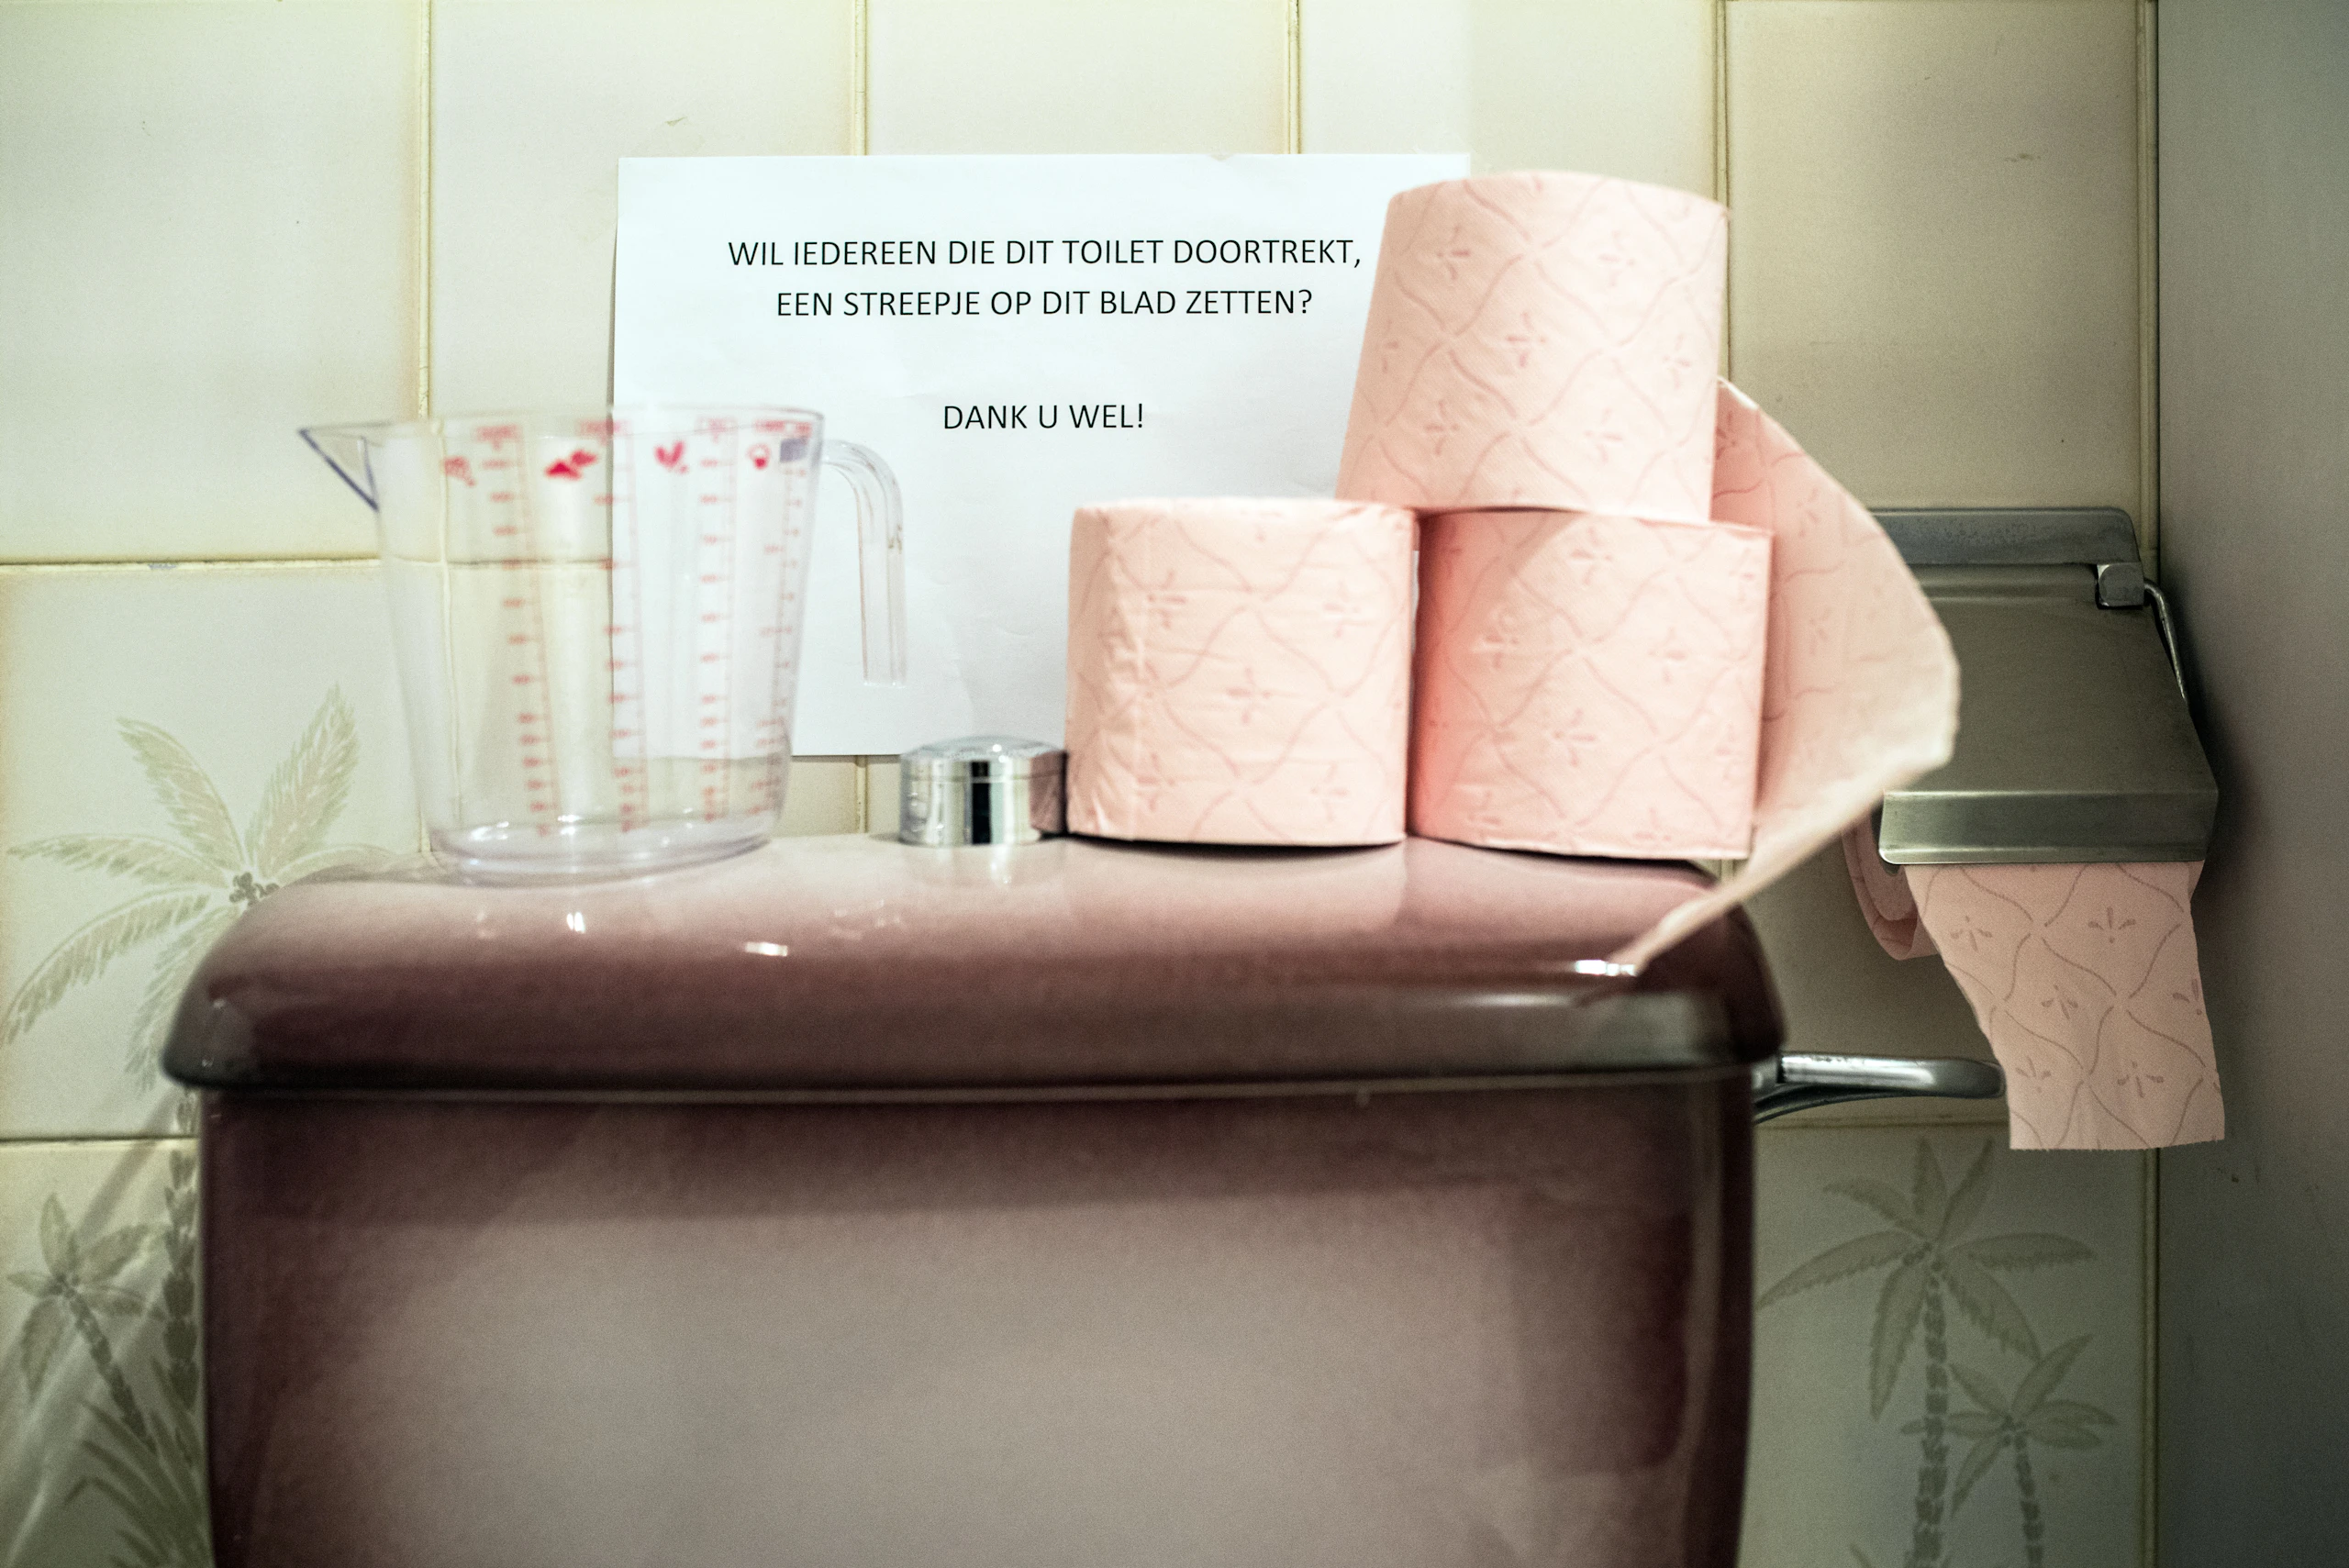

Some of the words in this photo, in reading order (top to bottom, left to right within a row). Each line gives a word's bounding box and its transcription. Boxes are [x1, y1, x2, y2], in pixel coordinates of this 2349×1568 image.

[728, 241, 784, 266] WIL
[795, 240, 936, 266] IEDEREEN
[949, 240, 995, 264] DIE
[1007, 239, 1053, 264] DIT
[1062, 239, 1164, 264] TOILET
[1174, 239, 1361, 269] DOORTREKT,
[777, 292, 832, 317] EEN
[843, 291, 980, 317] STREEPJE
[991, 291, 1031, 316] OP
[1043, 291, 1091, 315] DIT
[1100, 290, 1176, 315] BLAD
[1186, 289, 1312, 315] ZETTEN?
[944, 405, 1028, 429] DANK
[1039, 405, 1058, 429] U
[1068, 403, 1142, 428] WEL!
